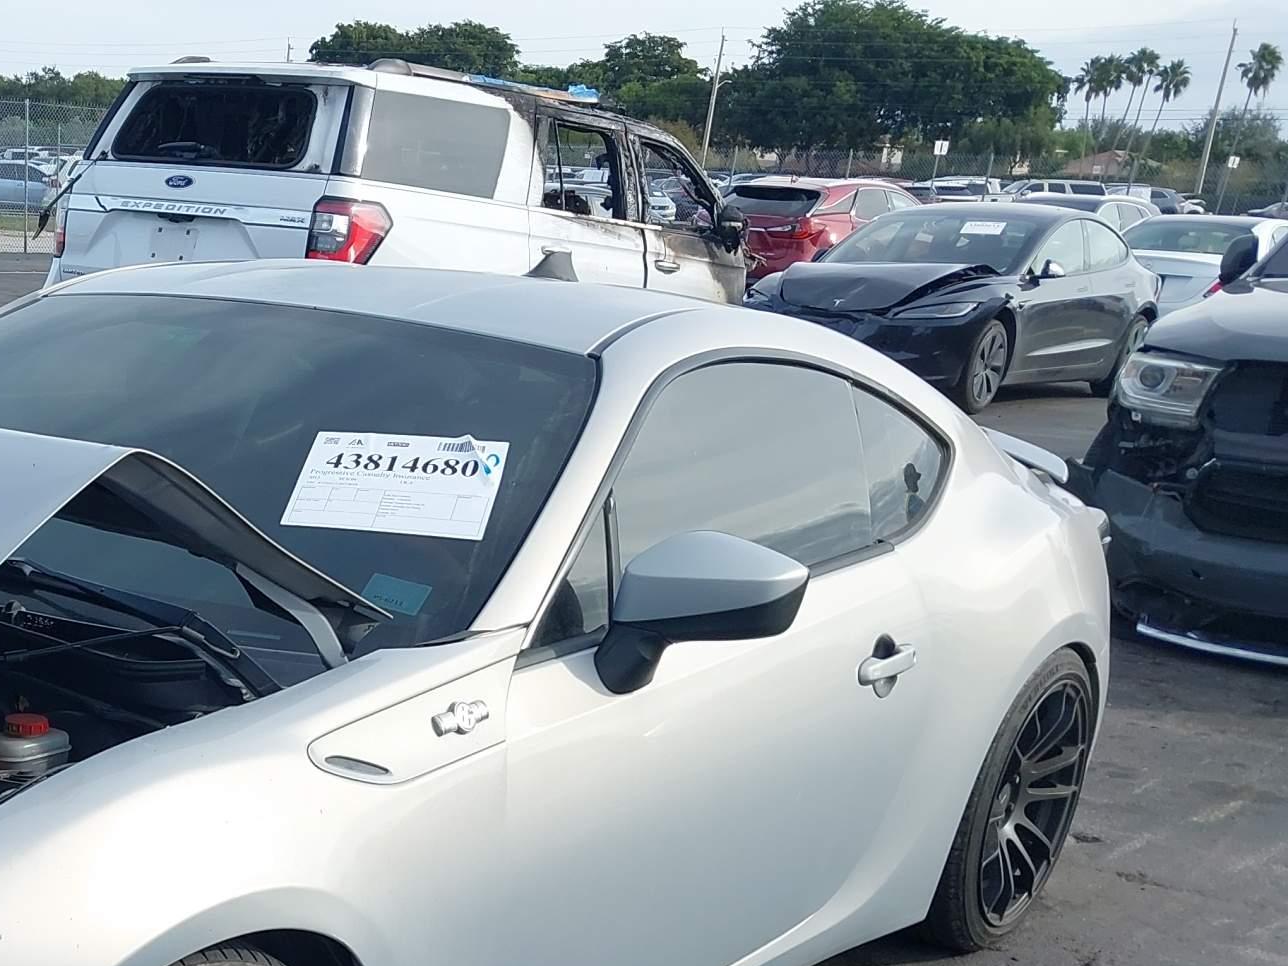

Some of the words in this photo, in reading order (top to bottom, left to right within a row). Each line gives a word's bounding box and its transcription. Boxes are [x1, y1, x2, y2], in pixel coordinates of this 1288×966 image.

[168, 176, 189, 186] Ford
[120, 200, 227, 216] EXPEDITION
[325, 452, 479, 478] 43814680
